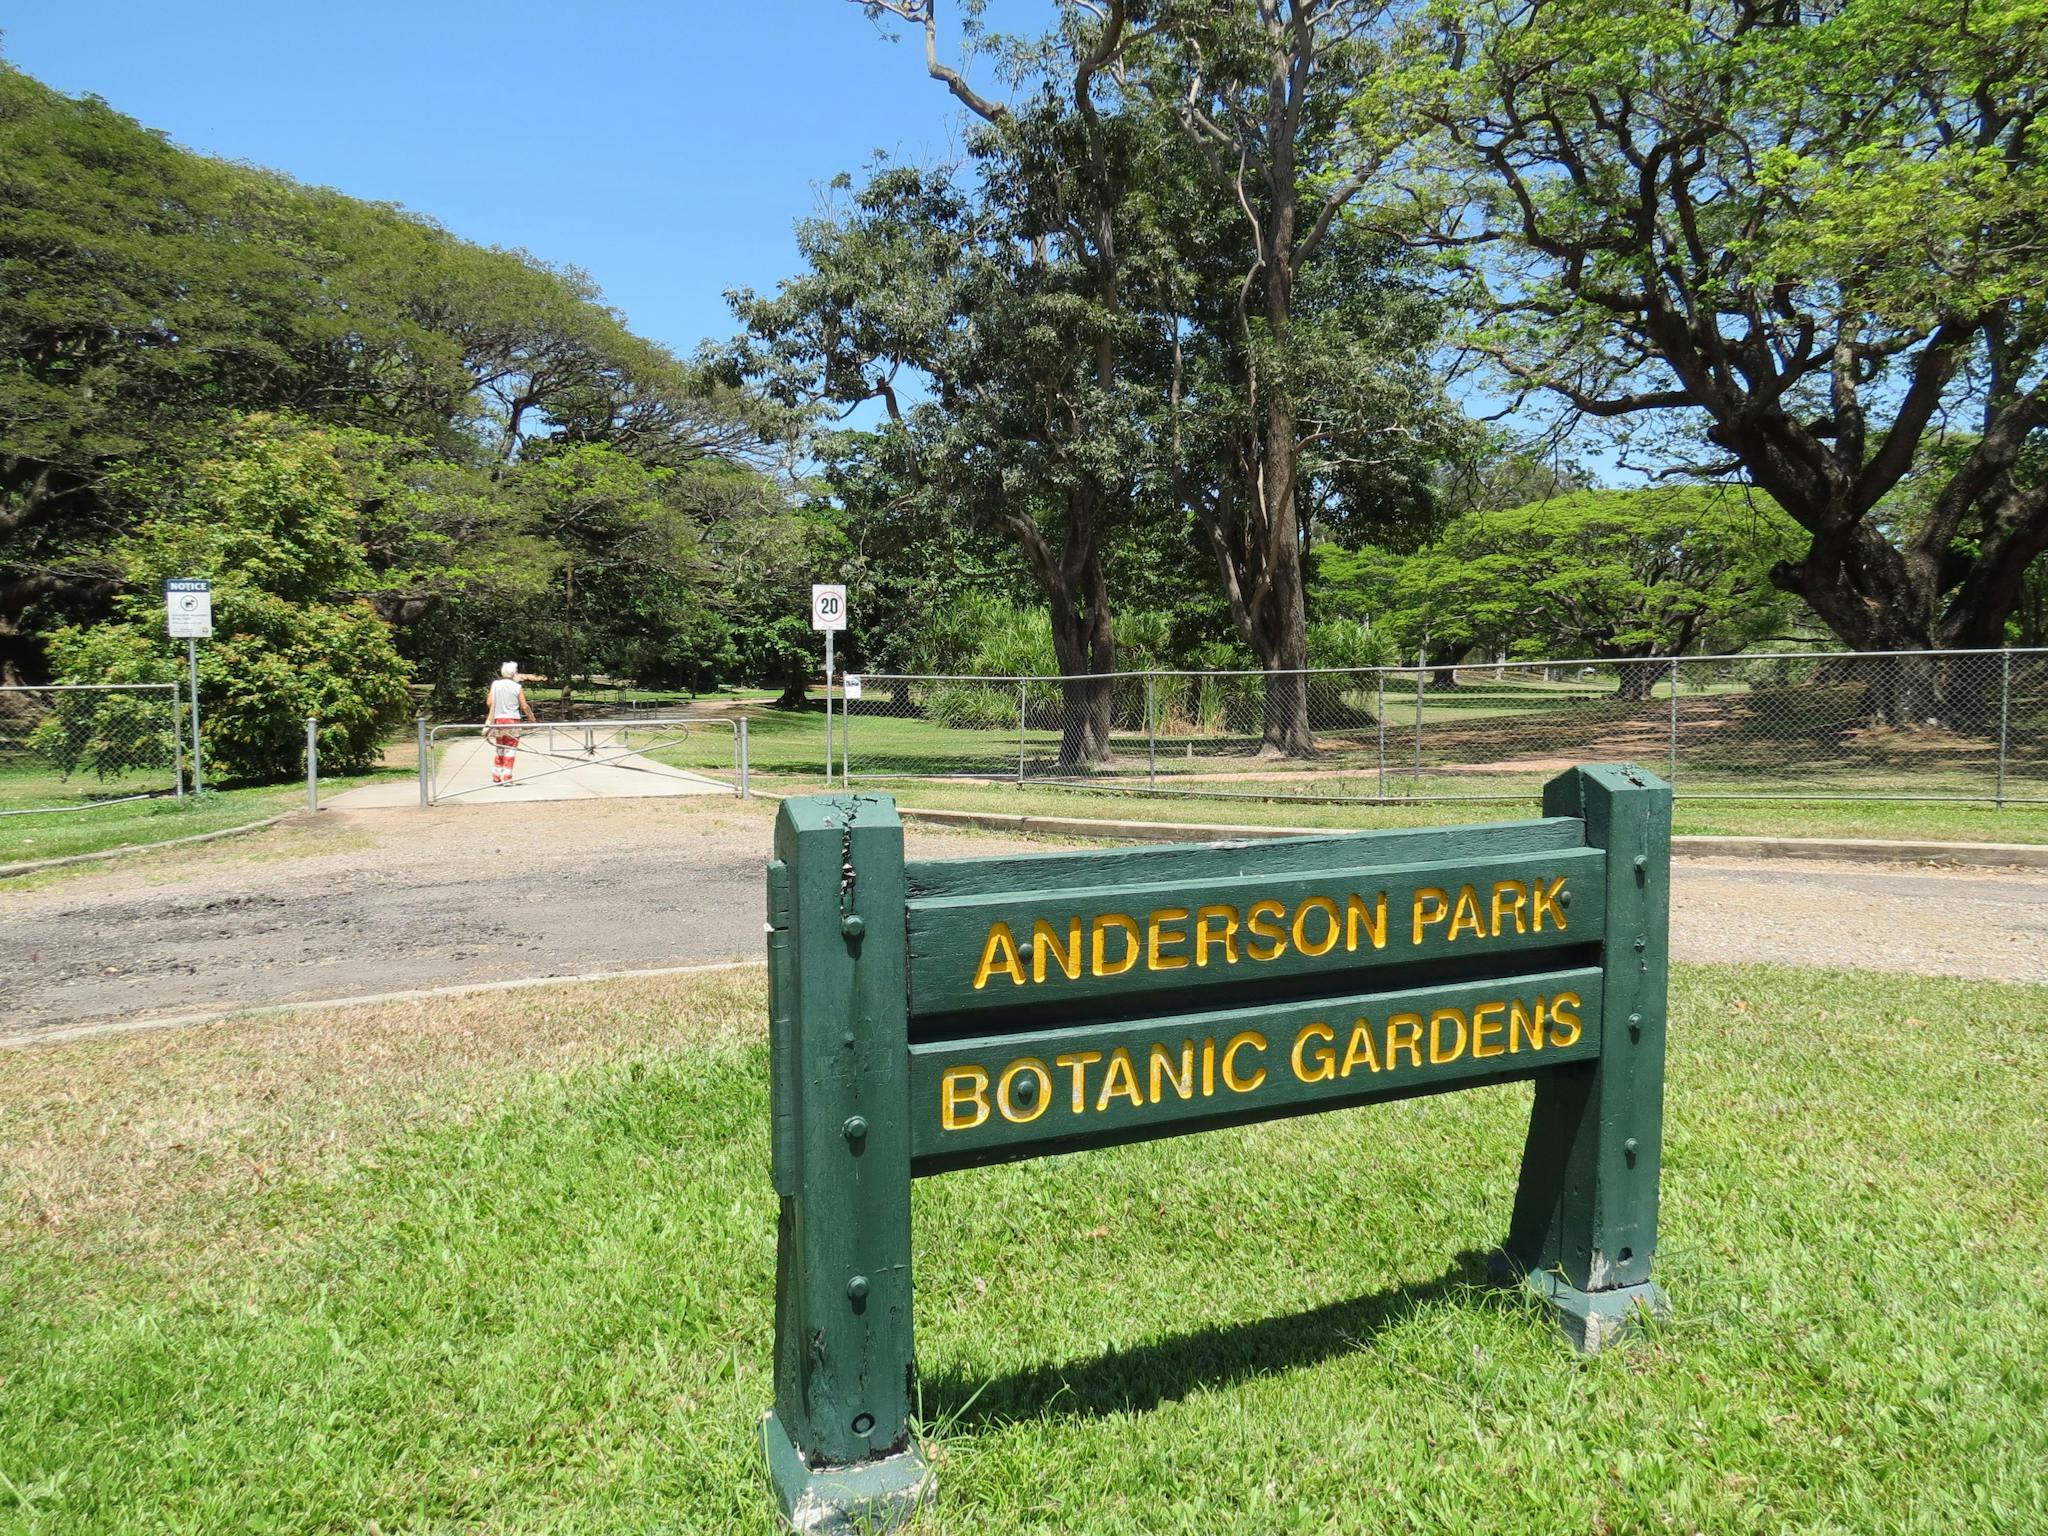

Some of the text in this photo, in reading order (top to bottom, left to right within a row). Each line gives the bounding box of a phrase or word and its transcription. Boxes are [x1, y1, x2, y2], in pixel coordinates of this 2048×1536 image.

[170, 582, 207, 591] NOTICE
[821, 598, 838, 614] 20
[973, 875, 1567, 989] ANDERSON PARK
[942, 992, 1581, 1130] BOTANIC GARDENS
